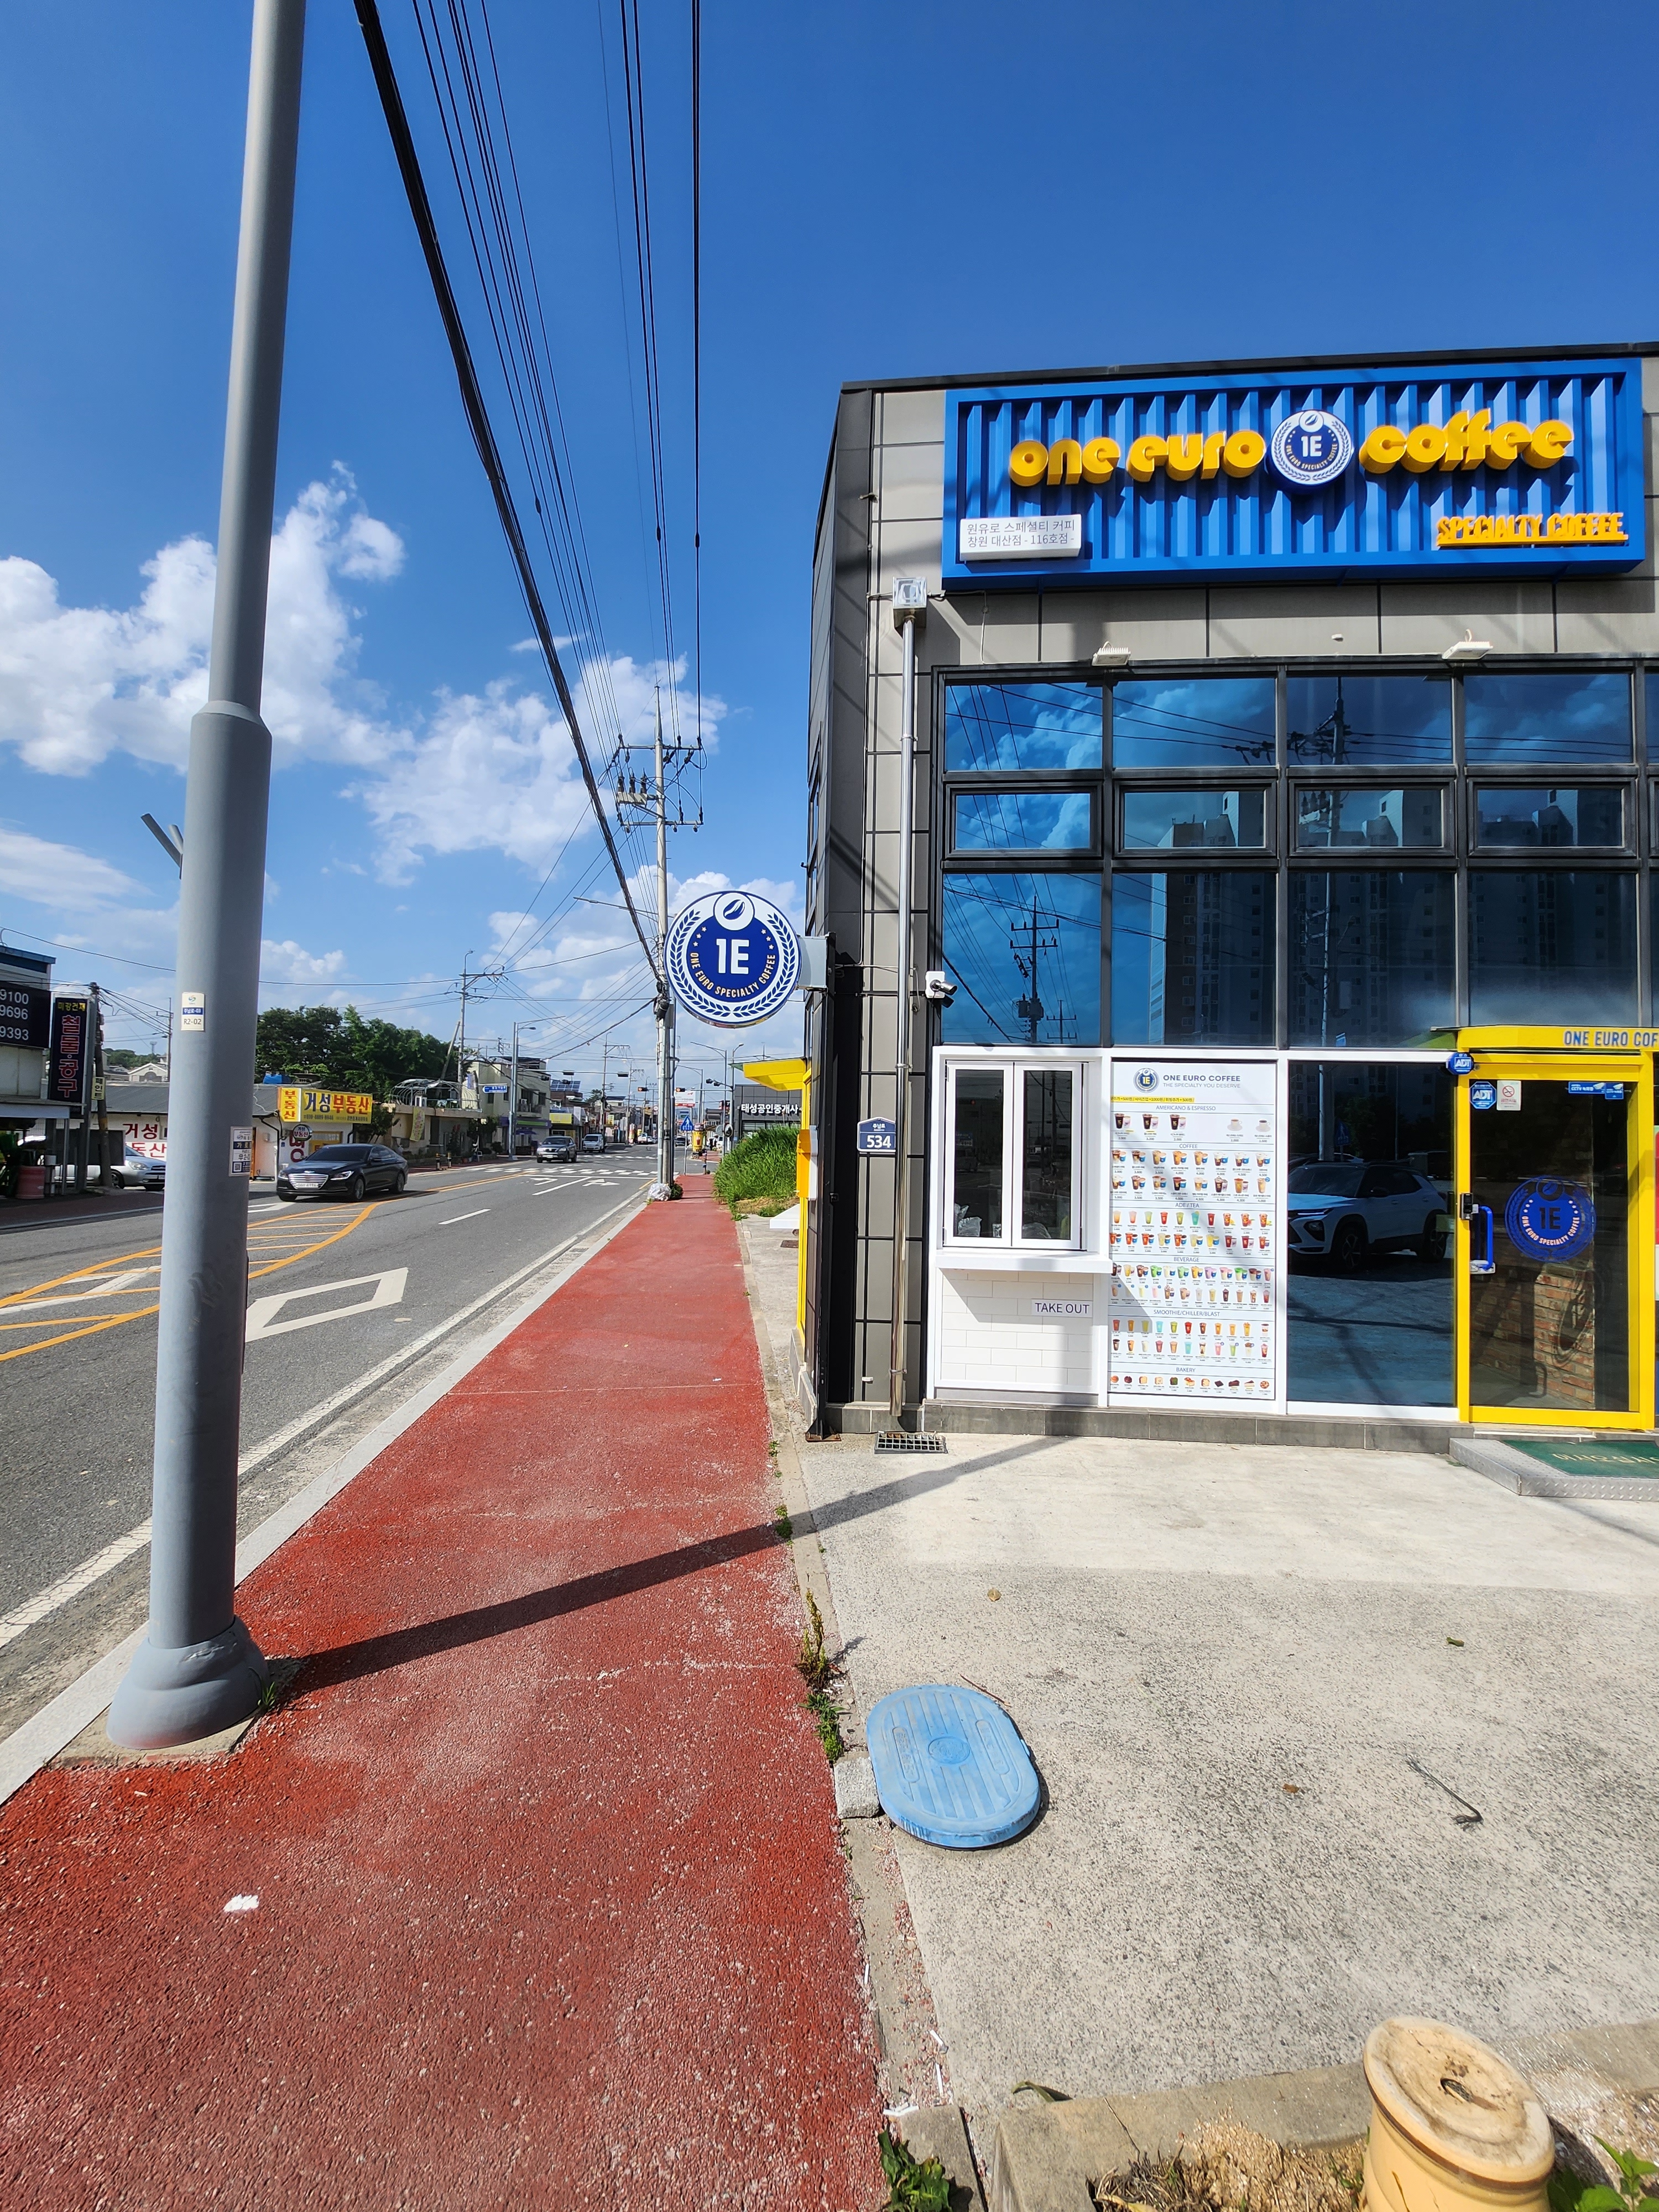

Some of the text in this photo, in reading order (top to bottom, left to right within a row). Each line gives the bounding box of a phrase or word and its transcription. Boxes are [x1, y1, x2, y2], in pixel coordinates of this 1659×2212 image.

[1009, 408, 1574, 486] one euro coffee
[1301, 436, 1322, 457] 1E
[967, 519, 1074, 535] 원유로 스페셜티 커피
[1436, 512, 1625, 541] SPECIALTY COFFEE
[968, 535, 988, 548] 창원
[992, 534, 1021, 547] 대산점
[1030, 532, 1068, 545] 116호점
[716, 938, 749, 974] 1E
[690, 952, 776, 998] ONE EURO SPECIALTY COFFEE
[1564, 1030, 1590, 1046] ONE
[1595, 1031, 1628, 1047] EURO
[1455, 1059, 1471, 1067] ADT
[1473, 1090, 1493, 1100] ADT
[283, 1090, 296, 1120] 부동산
[123, 1123, 158, 1140] 거성
[867, 1135, 892, 1148] 534
[1539, 1207, 1561, 1230] 1E
[1521, 1216, 1580, 1246] ONE EURO SPECIALTY COFFEE
[1035, 1302, 1090, 1314] TAKE OUT
[1153, 1309, 1220, 1317] SMOOTHIE/CHILLER/BLAST
